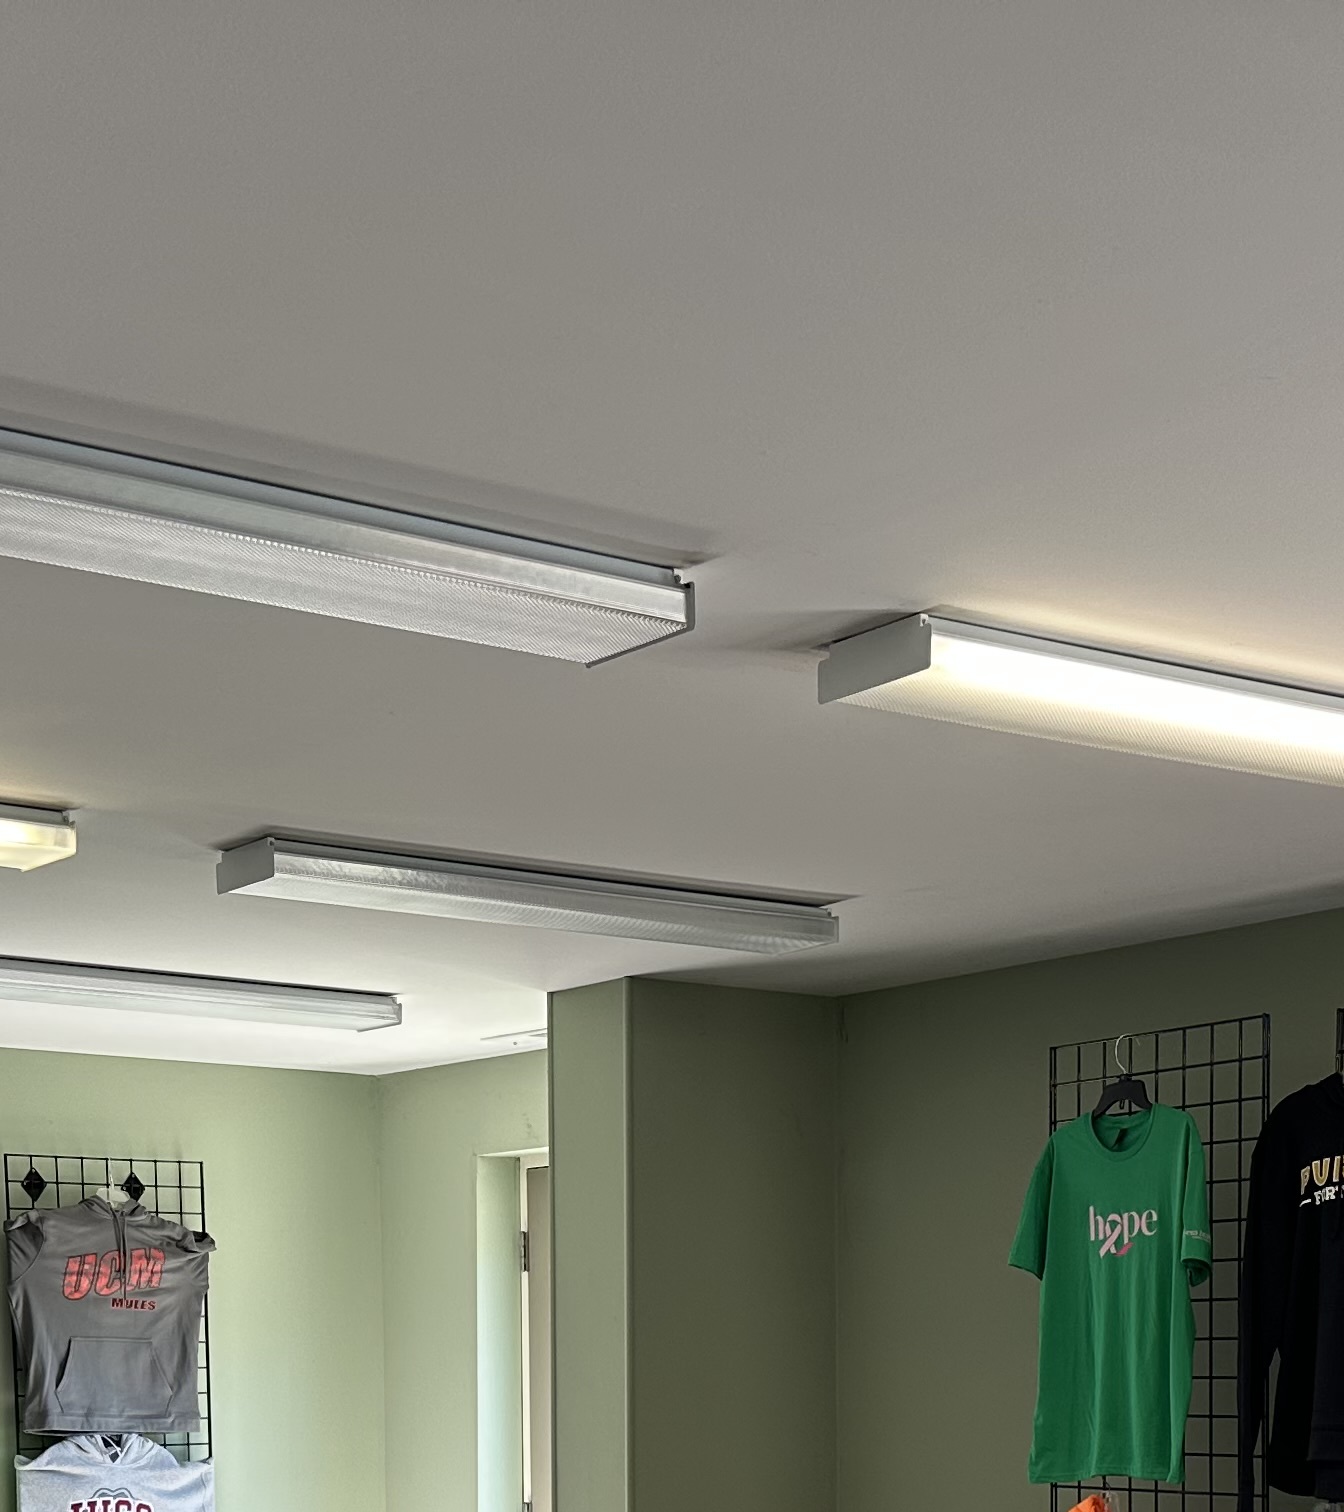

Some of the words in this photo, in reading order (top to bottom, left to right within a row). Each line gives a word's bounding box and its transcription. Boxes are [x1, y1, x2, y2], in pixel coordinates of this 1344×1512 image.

[1089, 1205, 1158, 1259] hope
[62, 1248, 165, 1300] UCM
[112, 1298, 156, 1310] MULES
